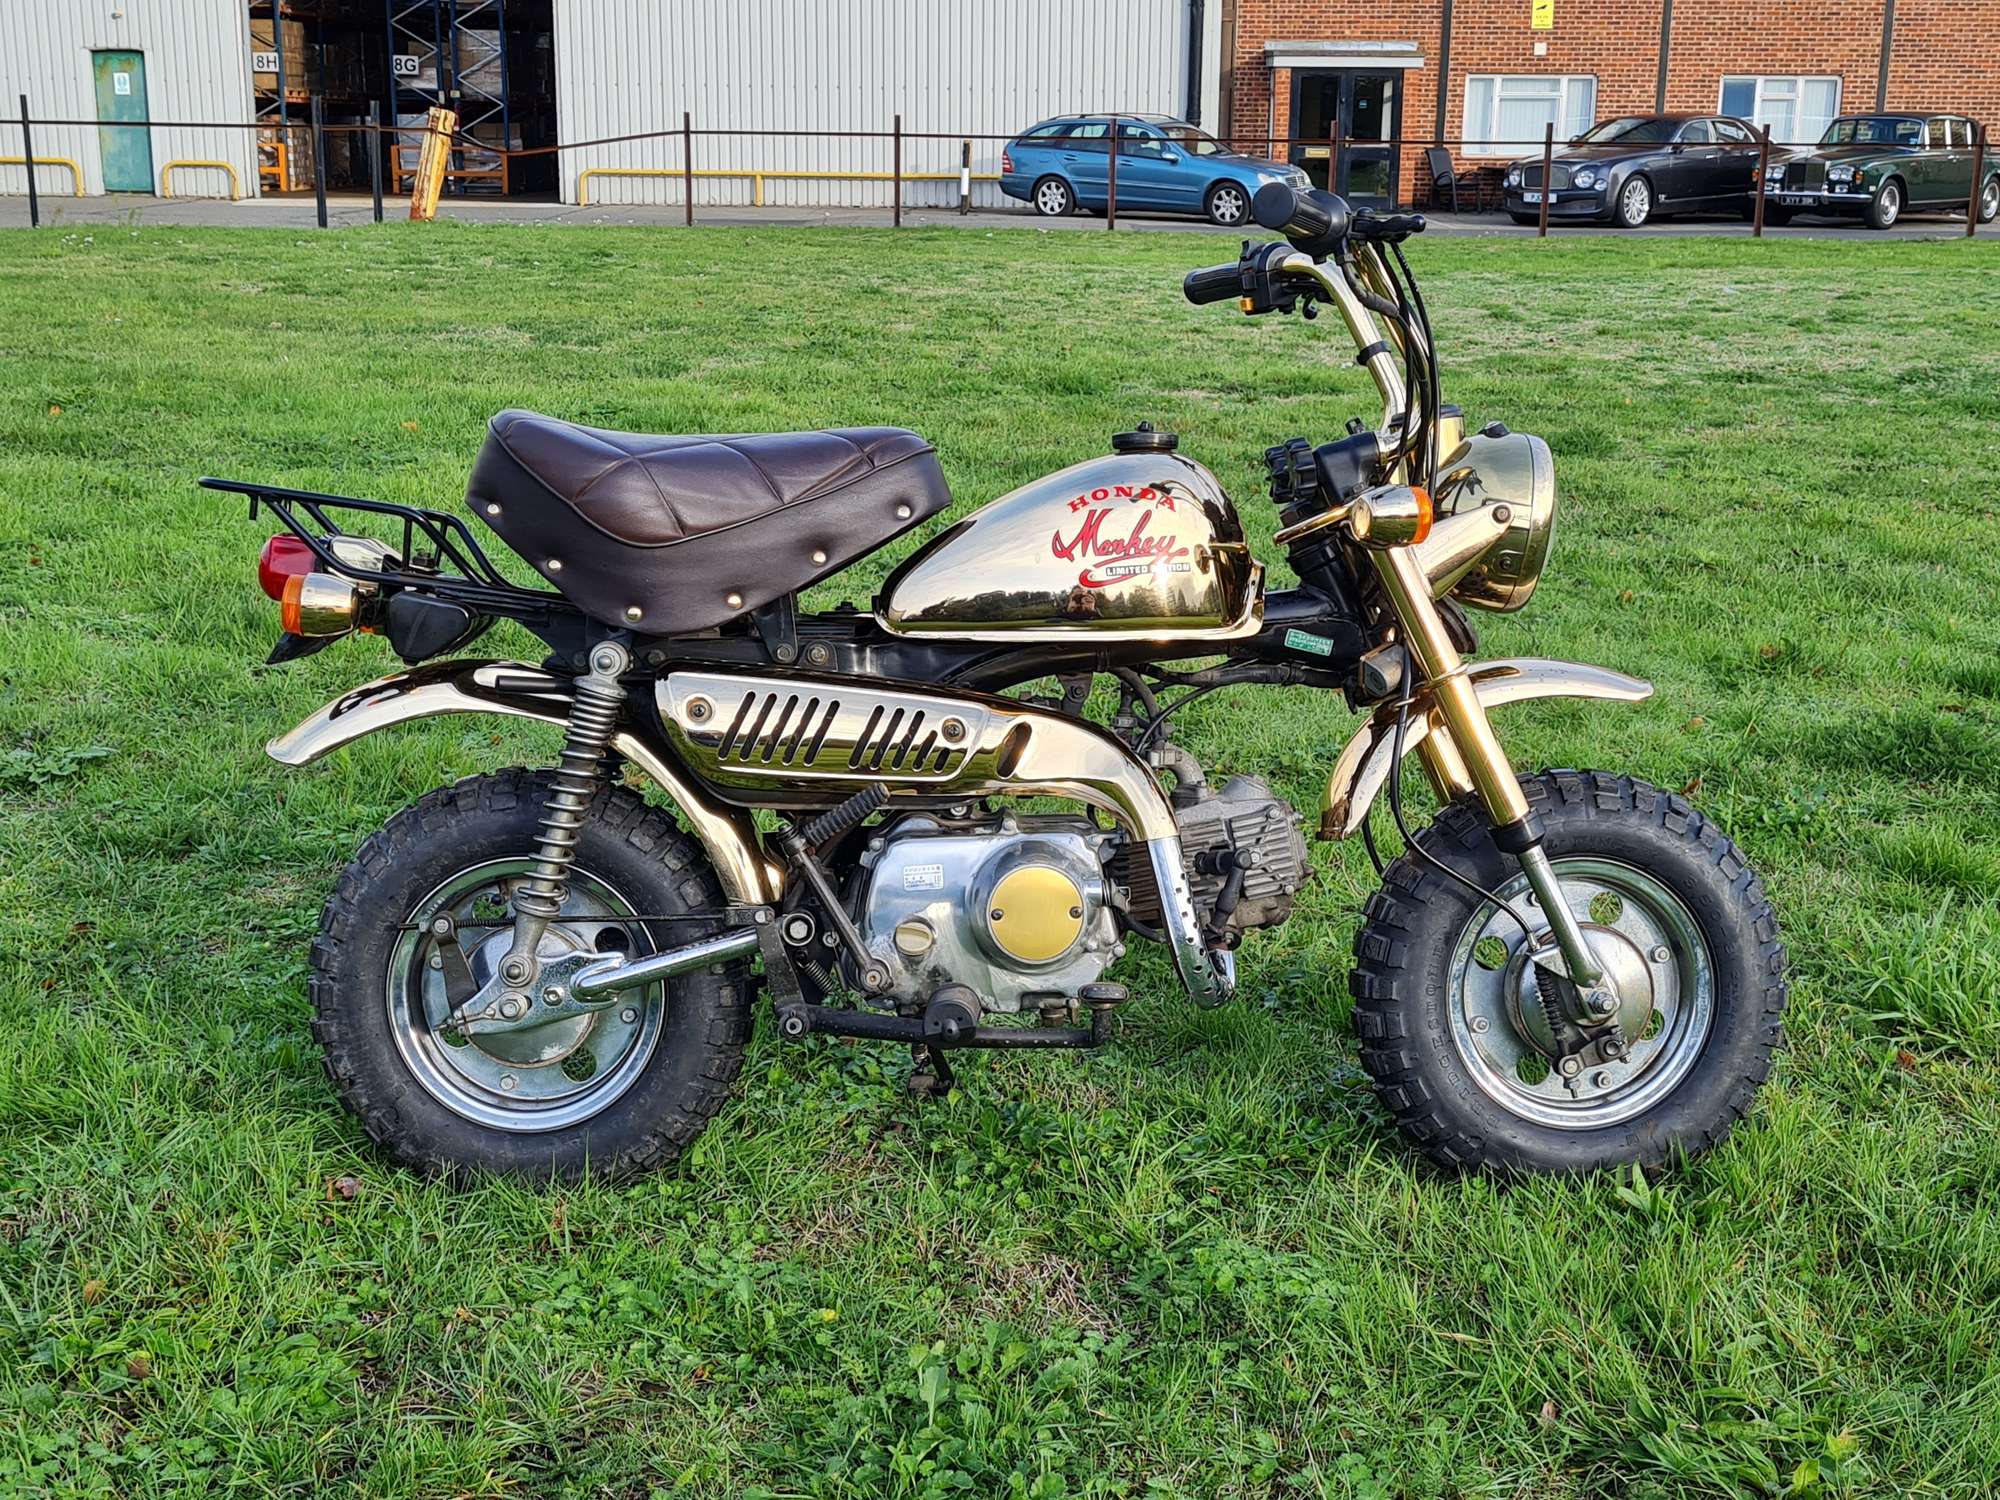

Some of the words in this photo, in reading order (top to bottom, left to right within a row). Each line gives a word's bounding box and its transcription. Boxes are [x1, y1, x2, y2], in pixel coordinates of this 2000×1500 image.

[256, 55, 277, 69] 8H
[394, 58, 417, 72] 8G
[1067, 486, 1176, 513] HONDA
[1051, 508, 1189, 575] Monkey
[1106, 565, 1149, 576] LIMITED
[1150, 562, 1191, 574] TION
